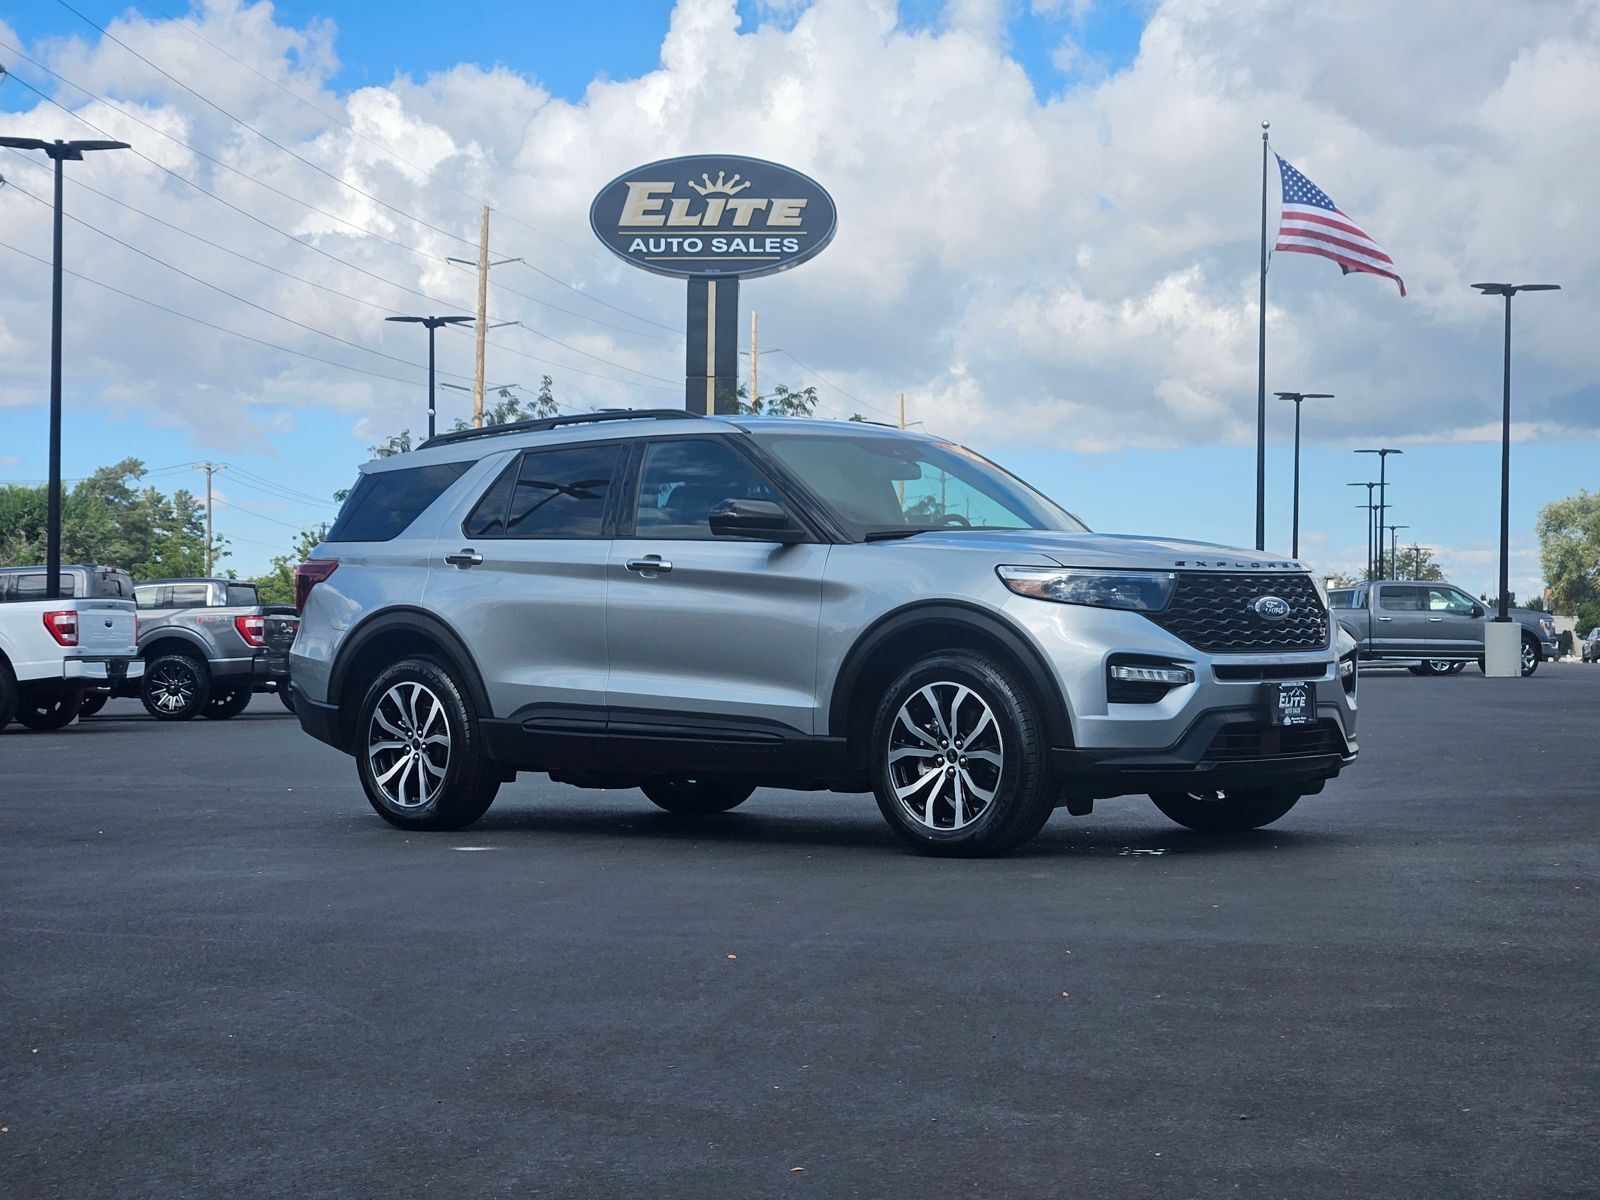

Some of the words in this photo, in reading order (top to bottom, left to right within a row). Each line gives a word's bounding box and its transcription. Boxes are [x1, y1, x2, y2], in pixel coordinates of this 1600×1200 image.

[618, 181, 808, 227] ELITE
[628, 238, 703, 253] AUTO
[711, 238, 799, 253] SALES
[1279, 692, 1306, 708] ELITE
